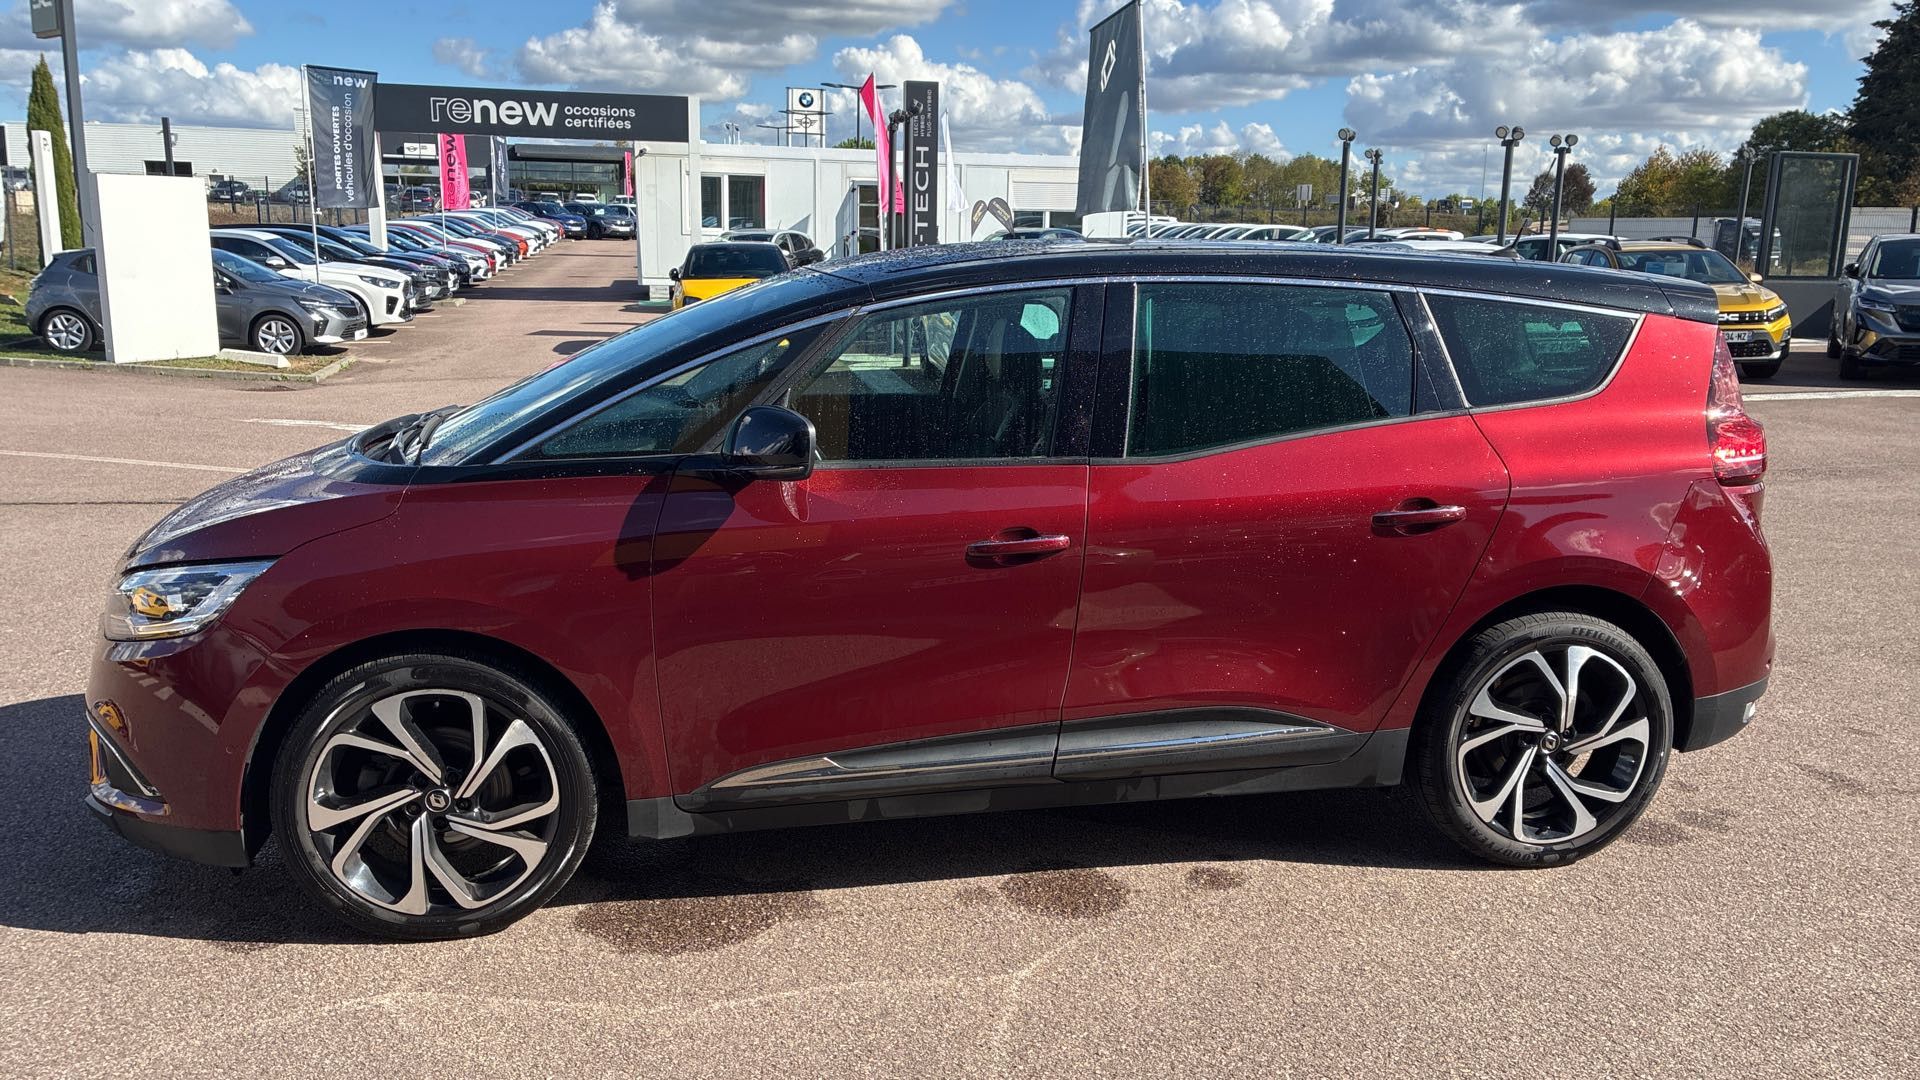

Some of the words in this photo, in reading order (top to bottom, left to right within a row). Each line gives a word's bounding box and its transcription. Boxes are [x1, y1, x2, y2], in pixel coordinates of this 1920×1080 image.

[332, 105, 341, 154] OUVERTES
[344, 93, 353, 151] d'occasion
[430, 97, 559, 127] renew
[564, 104, 636, 117] occasions
[565, 116, 632, 129] certifiées
[334, 155, 342, 189] PORTES
[344, 152, 354, 202] véhicules
[915, 146, 929, 247] -TECH
